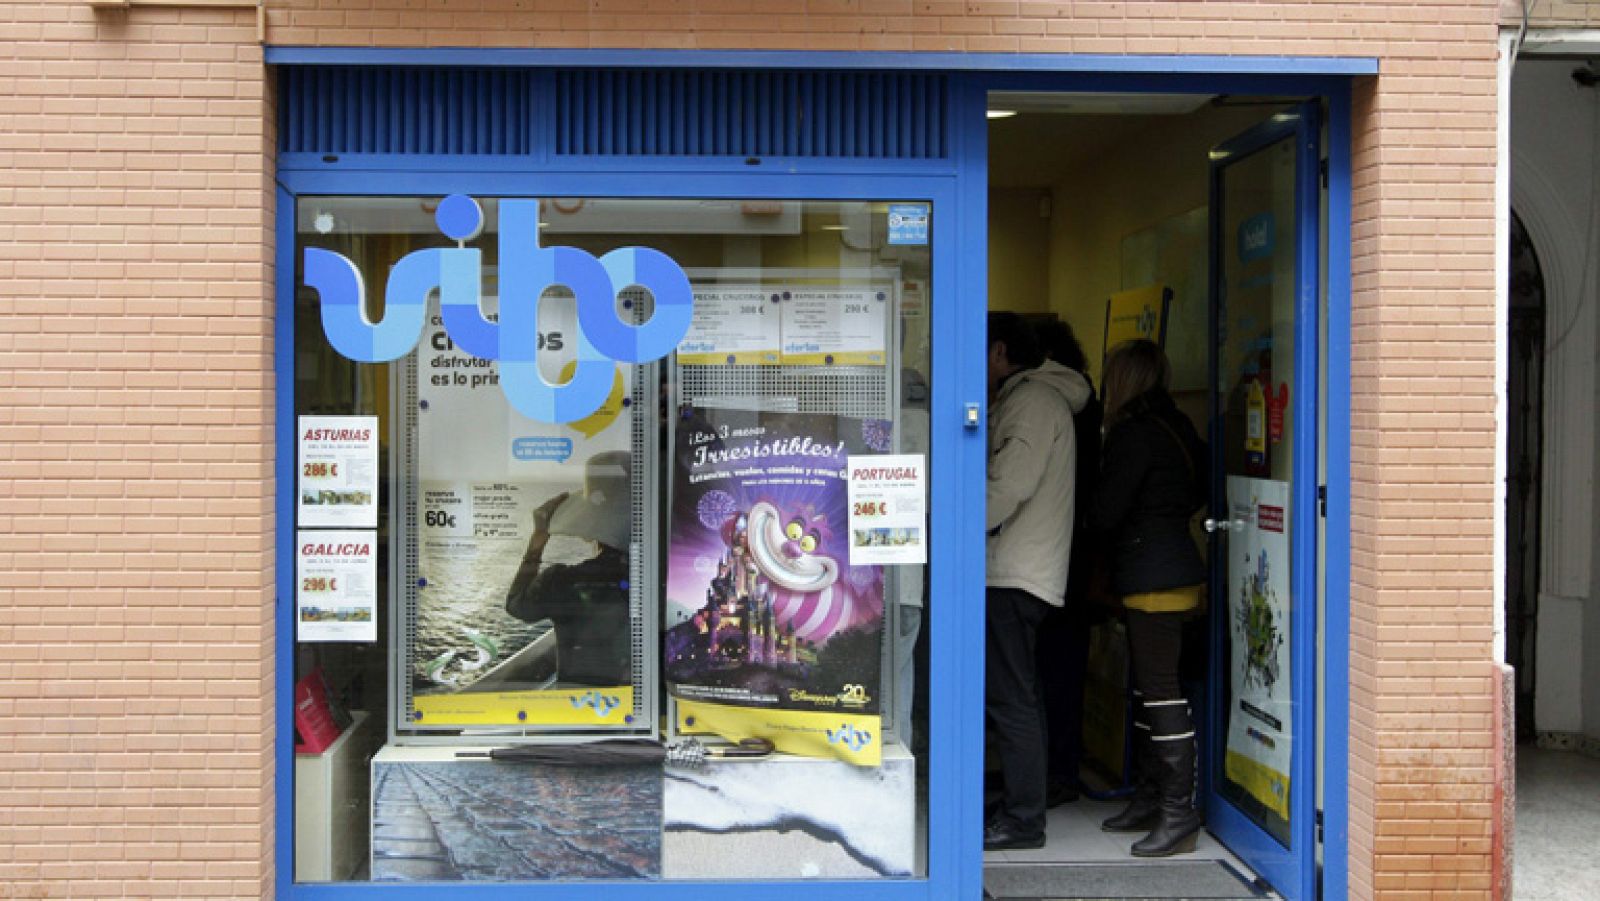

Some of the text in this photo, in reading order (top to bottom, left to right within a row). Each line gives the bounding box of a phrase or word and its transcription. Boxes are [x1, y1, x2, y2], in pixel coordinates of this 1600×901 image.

[303, 193, 694, 424] vibo
[430, 374, 449, 385] es
[453, 371, 467, 385] lo
[303, 429, 370, 442] ASTURIAS
[852, 467, 918, 481] PORTUGAL
[302, 544, 370, 556] GALICIA
[569, 691, 621, 717] vibo
[826, 723, 872, 752] vibo
